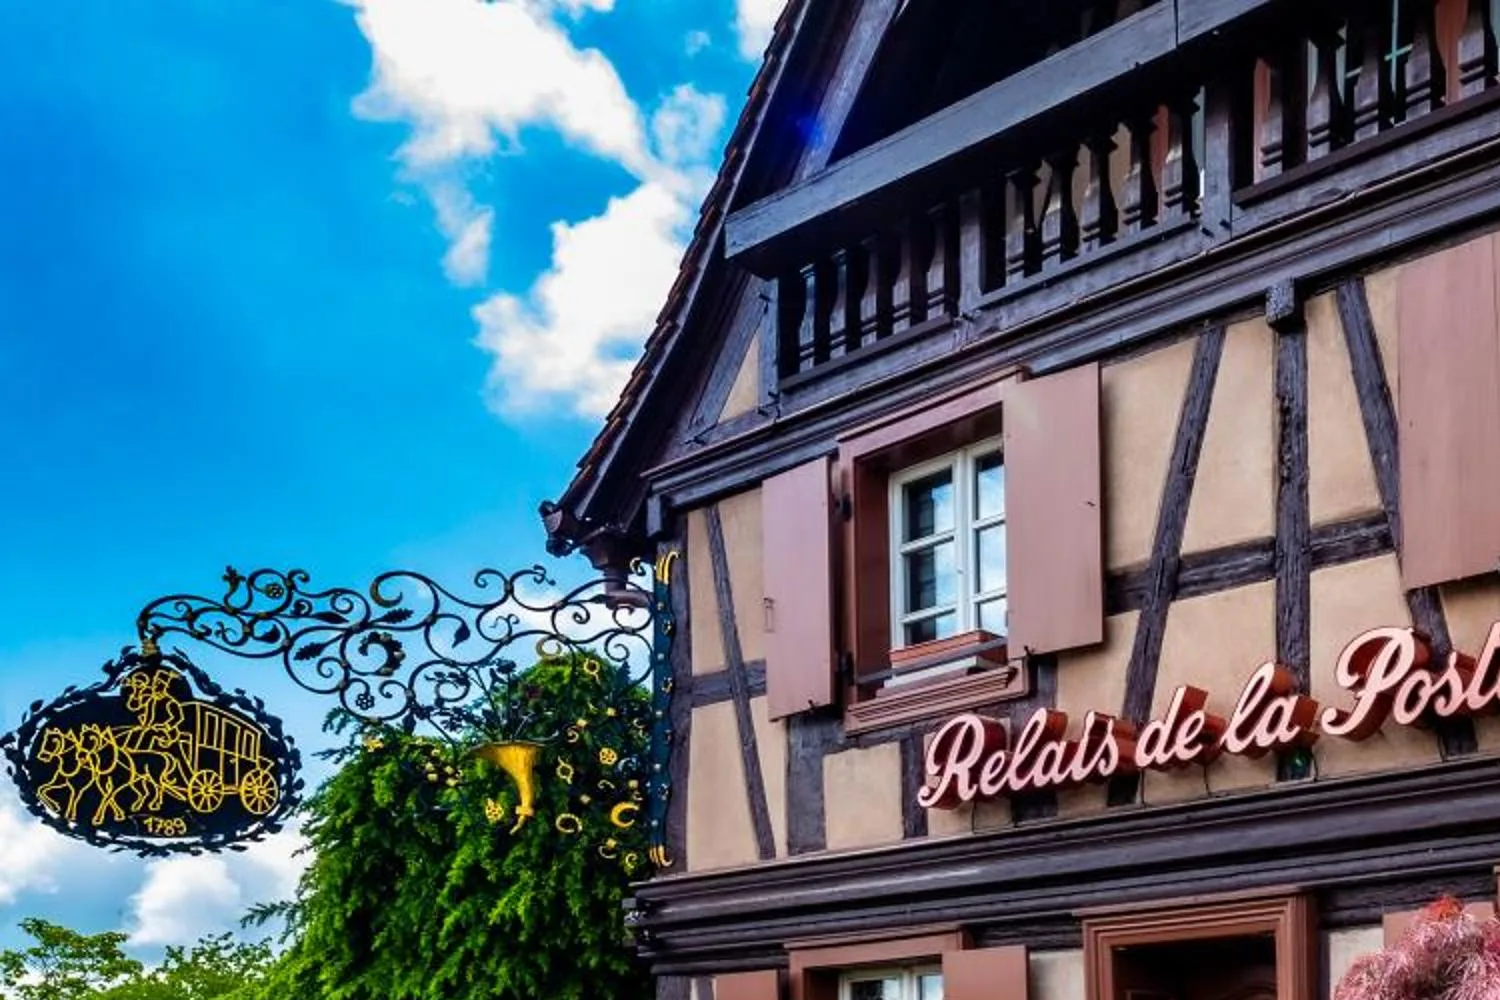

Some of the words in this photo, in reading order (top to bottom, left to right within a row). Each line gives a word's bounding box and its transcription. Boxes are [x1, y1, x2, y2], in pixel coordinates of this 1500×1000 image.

[918, 707, 1119, 808] Relais
[1135, 686, 1206, 768] de
[1220, 662, 1301, 753] la
[143, 817, 187, 837] 1789
